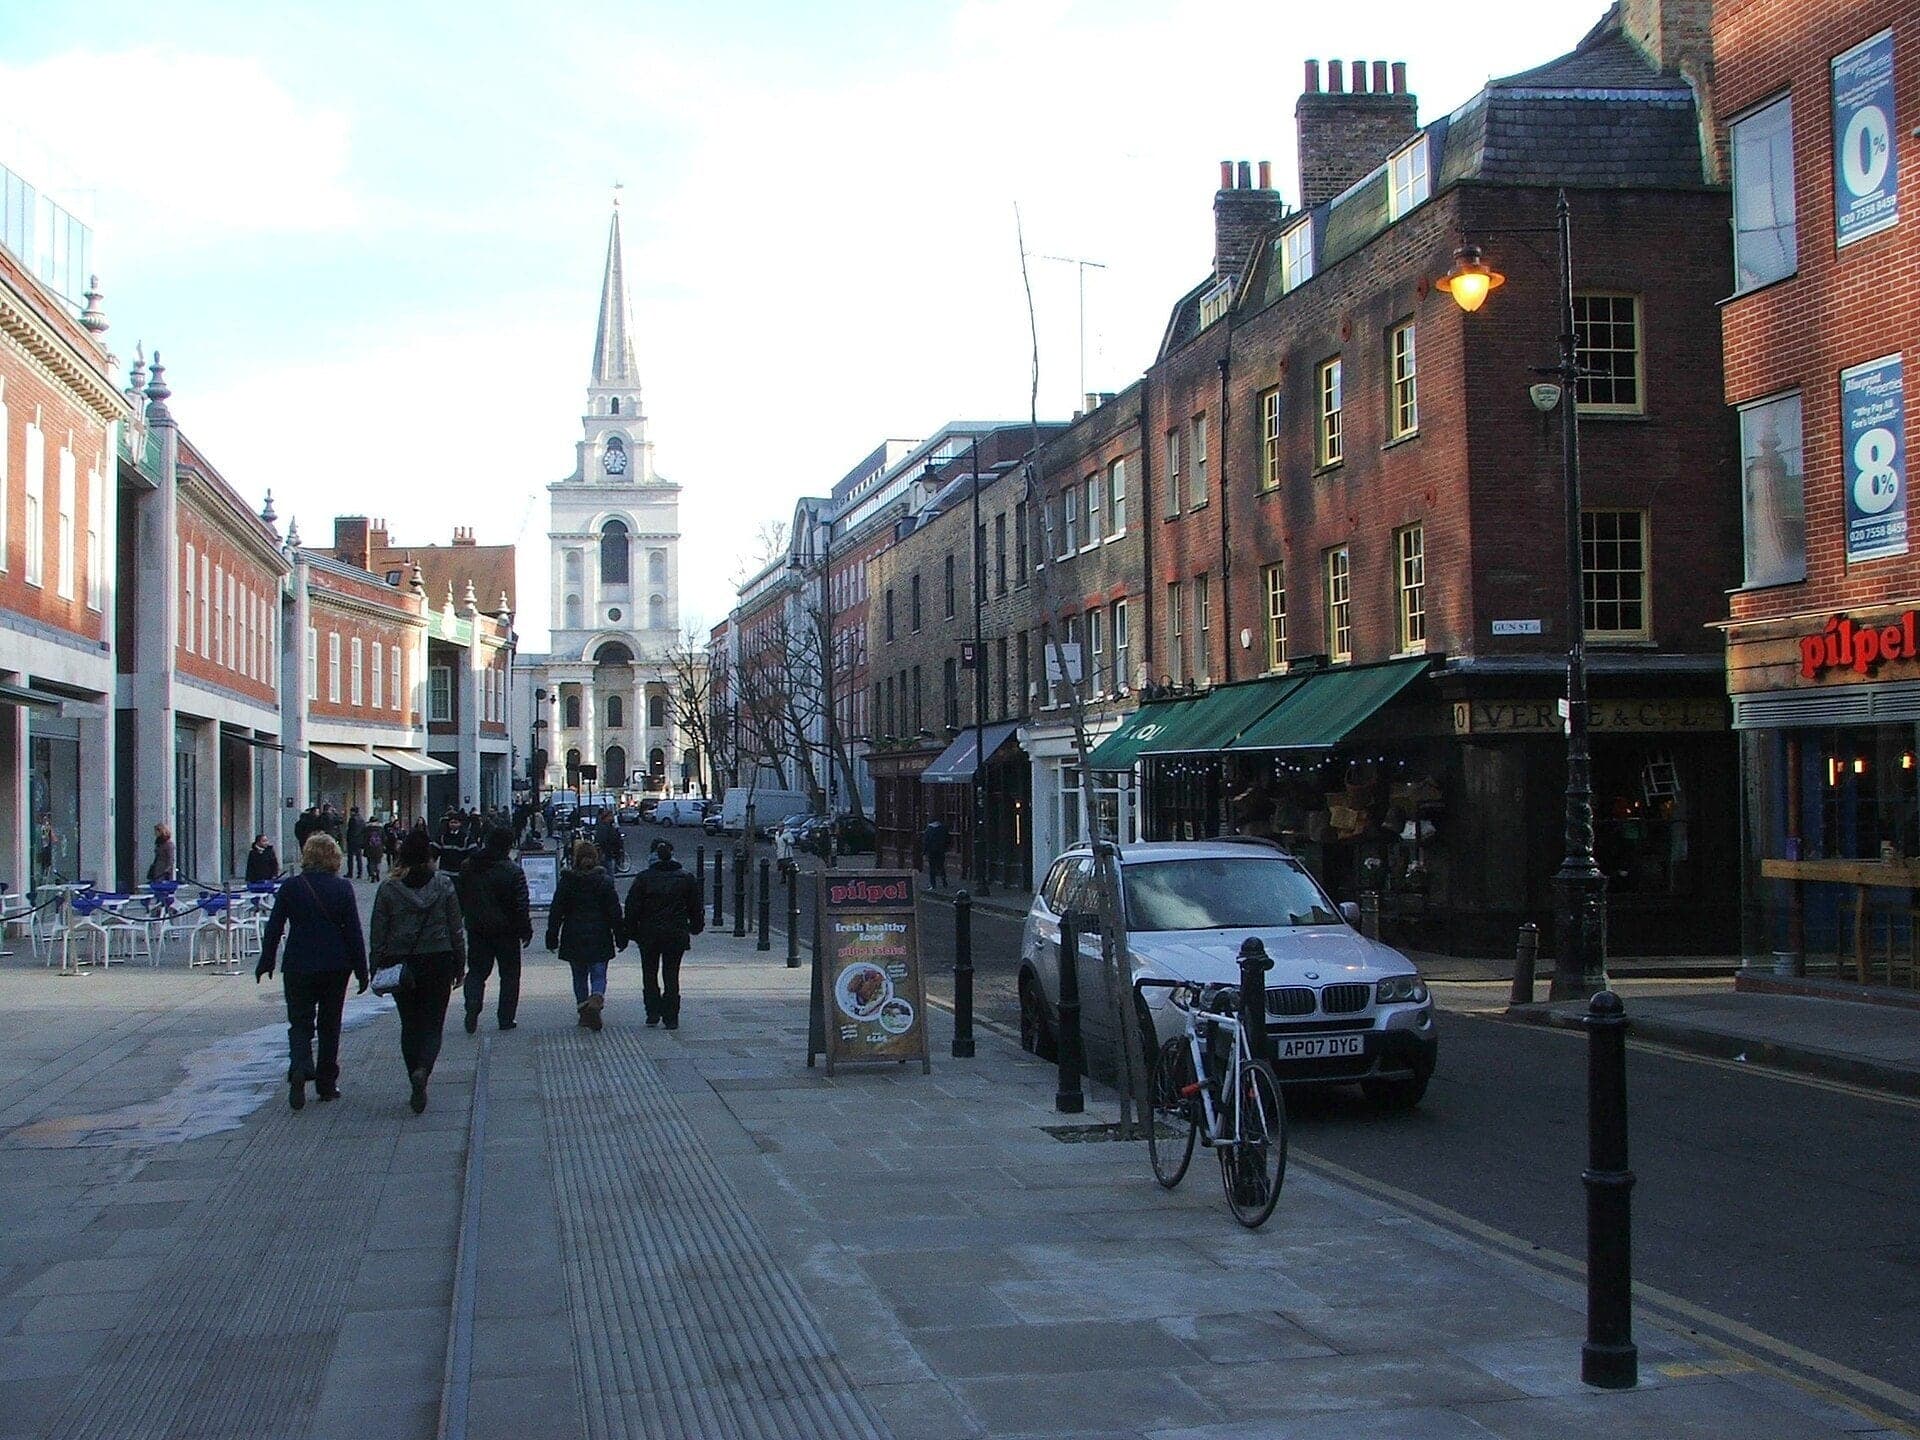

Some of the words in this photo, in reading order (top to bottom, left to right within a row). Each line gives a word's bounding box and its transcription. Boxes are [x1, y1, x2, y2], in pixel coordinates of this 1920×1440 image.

[1494, 623, 1516, 633] GUN
[1518, 622, 1530, 632] ST
[1479, 703, 1603, 728] VERE
[835, 922, 864, 932] fresh
[865, 922, 907, 933] healthy
[858, 932, 884, 941] food
[1284, 1040, 1325, 1057] AP07
[1328, 1038, 1358, 1055] DYG
